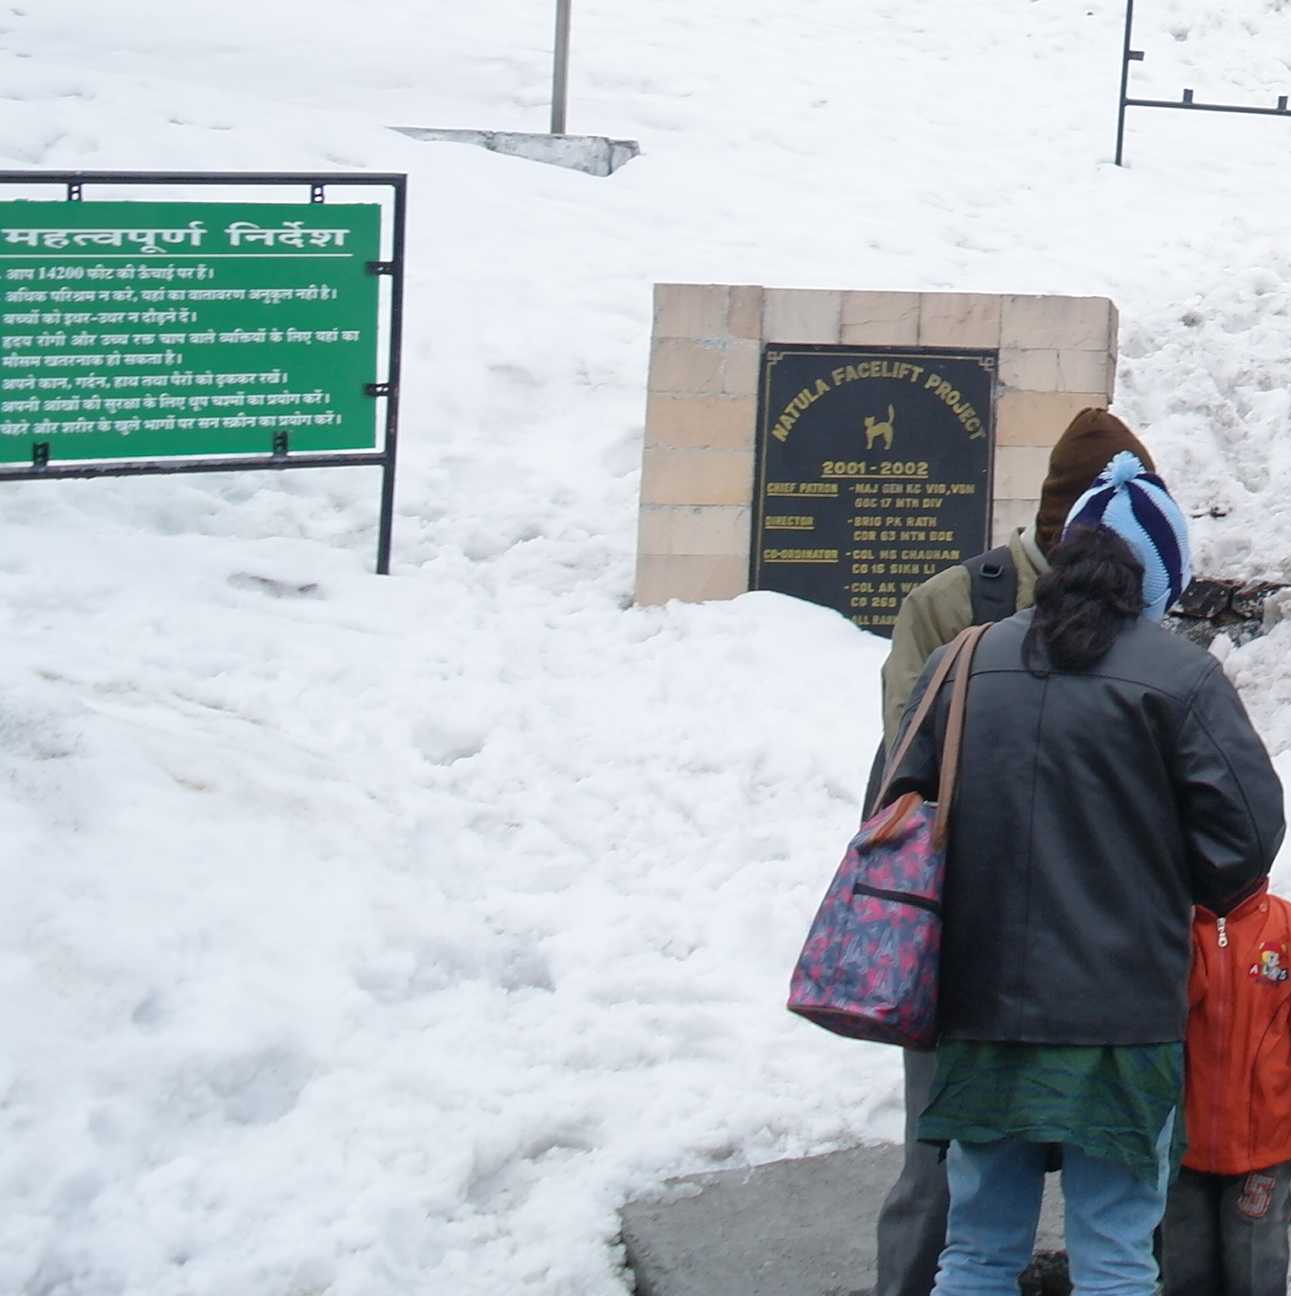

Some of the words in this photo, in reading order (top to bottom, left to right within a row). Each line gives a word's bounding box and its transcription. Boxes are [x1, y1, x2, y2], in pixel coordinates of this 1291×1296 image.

[224, 221, 350, 247] निर्देश
[38, 266, 84, 280] 14200
[116, 263, 136, 280] की
[177, 267, 195, 280] पर
[167, 289, 186, 301] का
[41, 309, 61, 324] को
[71, 331, 97, 347] और
[341, 330, 360, 342] का
[82, 394, 101, 410] की
[247, 394, 264, 406] का
[771, 379, 831, 443] NATULA
[831, 361, 924, 386] FACELIFT
[924, 373, 987, 441] PROJECT
[32, 418, 59, 435] और
[177, 417, 194, 430] पर
[259, 415, 276, 427] का
[922, 498, 943, 508] DIV
